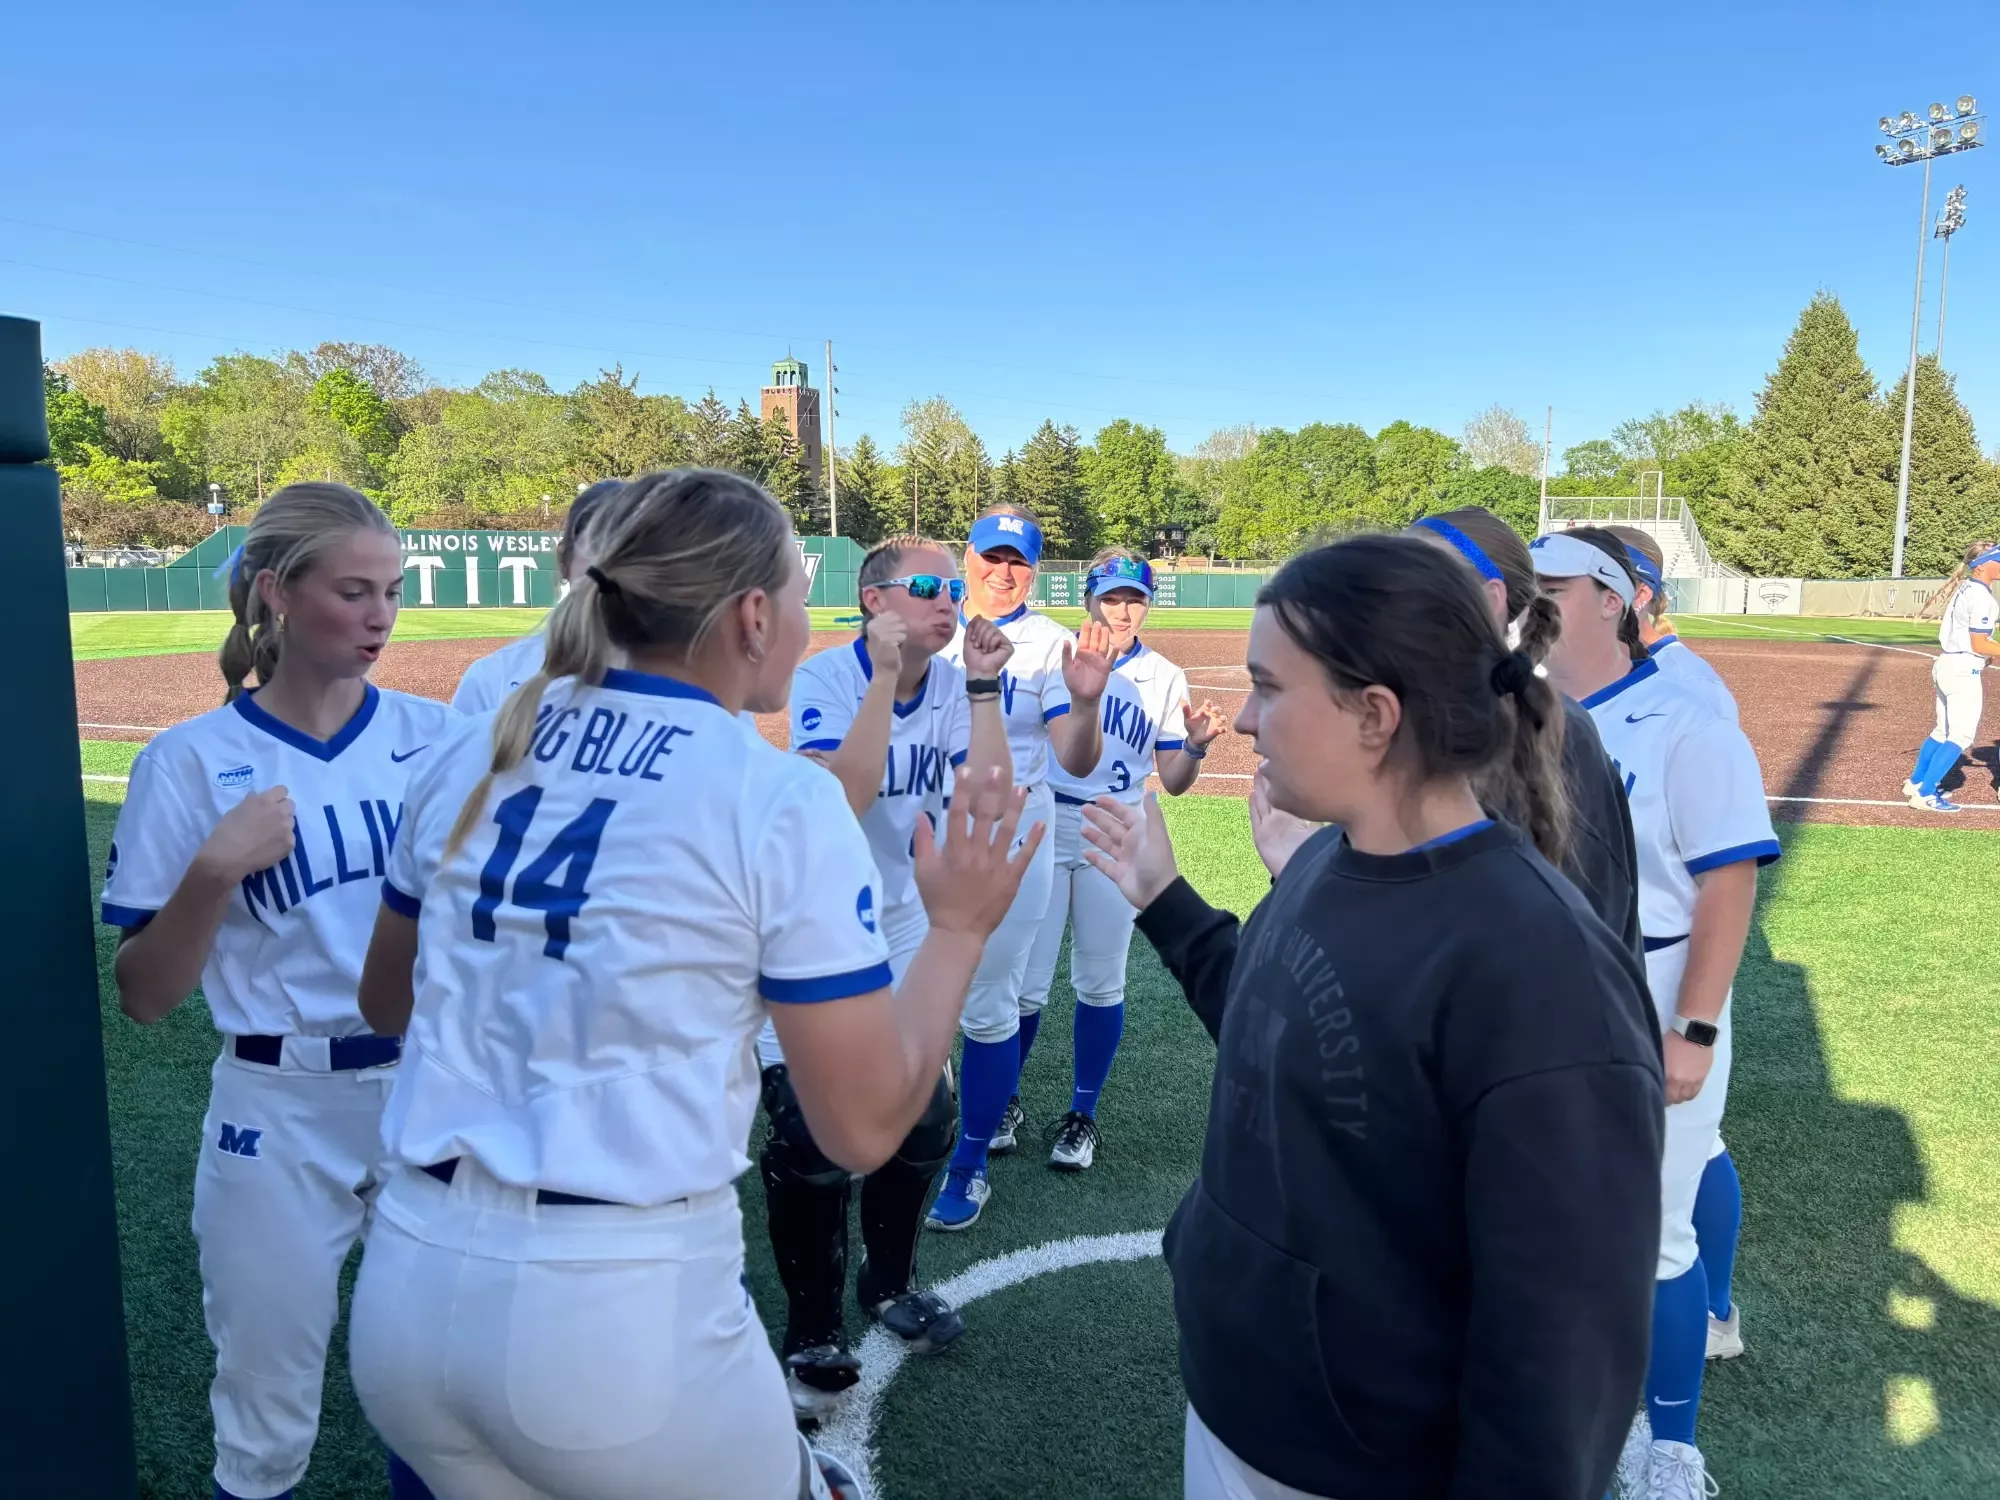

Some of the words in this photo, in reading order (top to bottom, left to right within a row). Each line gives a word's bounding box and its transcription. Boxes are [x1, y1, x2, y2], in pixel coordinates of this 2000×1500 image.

[401, 534, 478, 551] LINOIS
[998, 516, 1024, 535] M
[571, 706, 694, 782] BLUE
[1107, 760, 1131, 792] 3
[471, 784, 618, 962] 14
[217, 1120, 264, 1160] M
